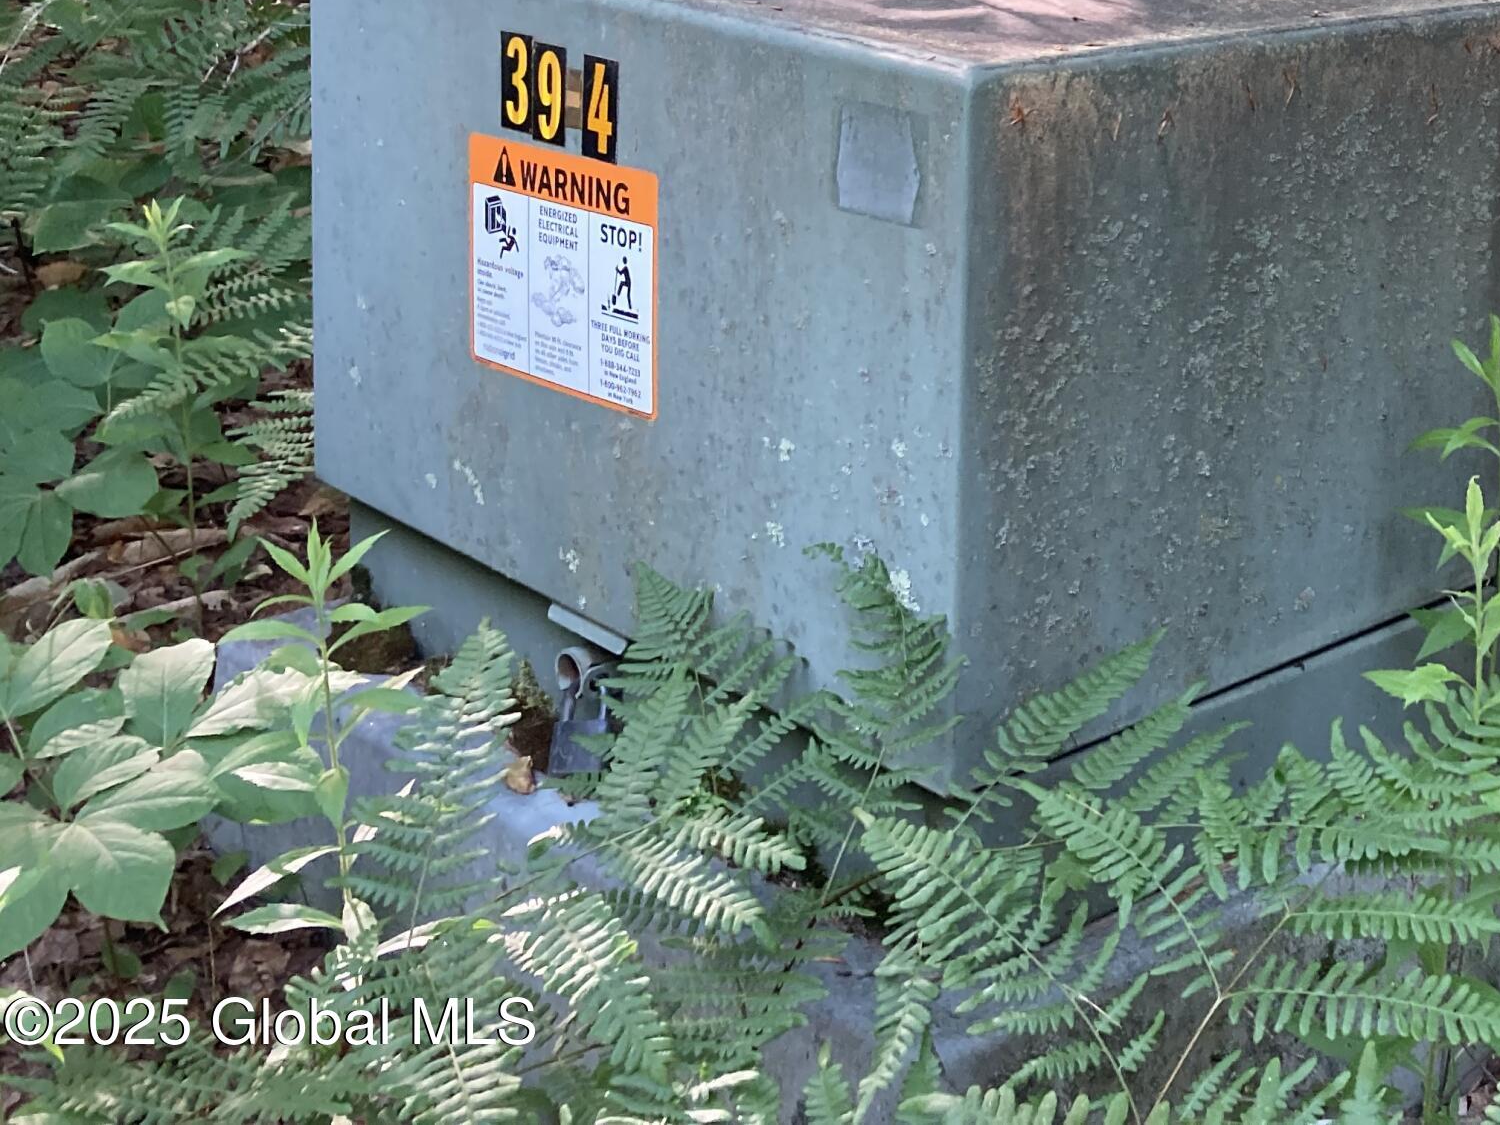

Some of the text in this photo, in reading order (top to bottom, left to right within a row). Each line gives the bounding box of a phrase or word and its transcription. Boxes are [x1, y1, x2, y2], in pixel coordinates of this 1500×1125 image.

[520, 159, 630, 216] WARNING
[540, 205, 578, 224] ENERGIZED
[538, 218, 579, 238] ELECTRICAL
[600, 224, 642, 252] STOP!
[538, 231, 578, 251] EQUIPMENT
[591, 319, 608, 332] THREE
[624, 330, 651, 344] WORKING
[601, 333, 640, 352] DAYS BEFORE
[601, 343, 640, 362] YOU DIG CALL
